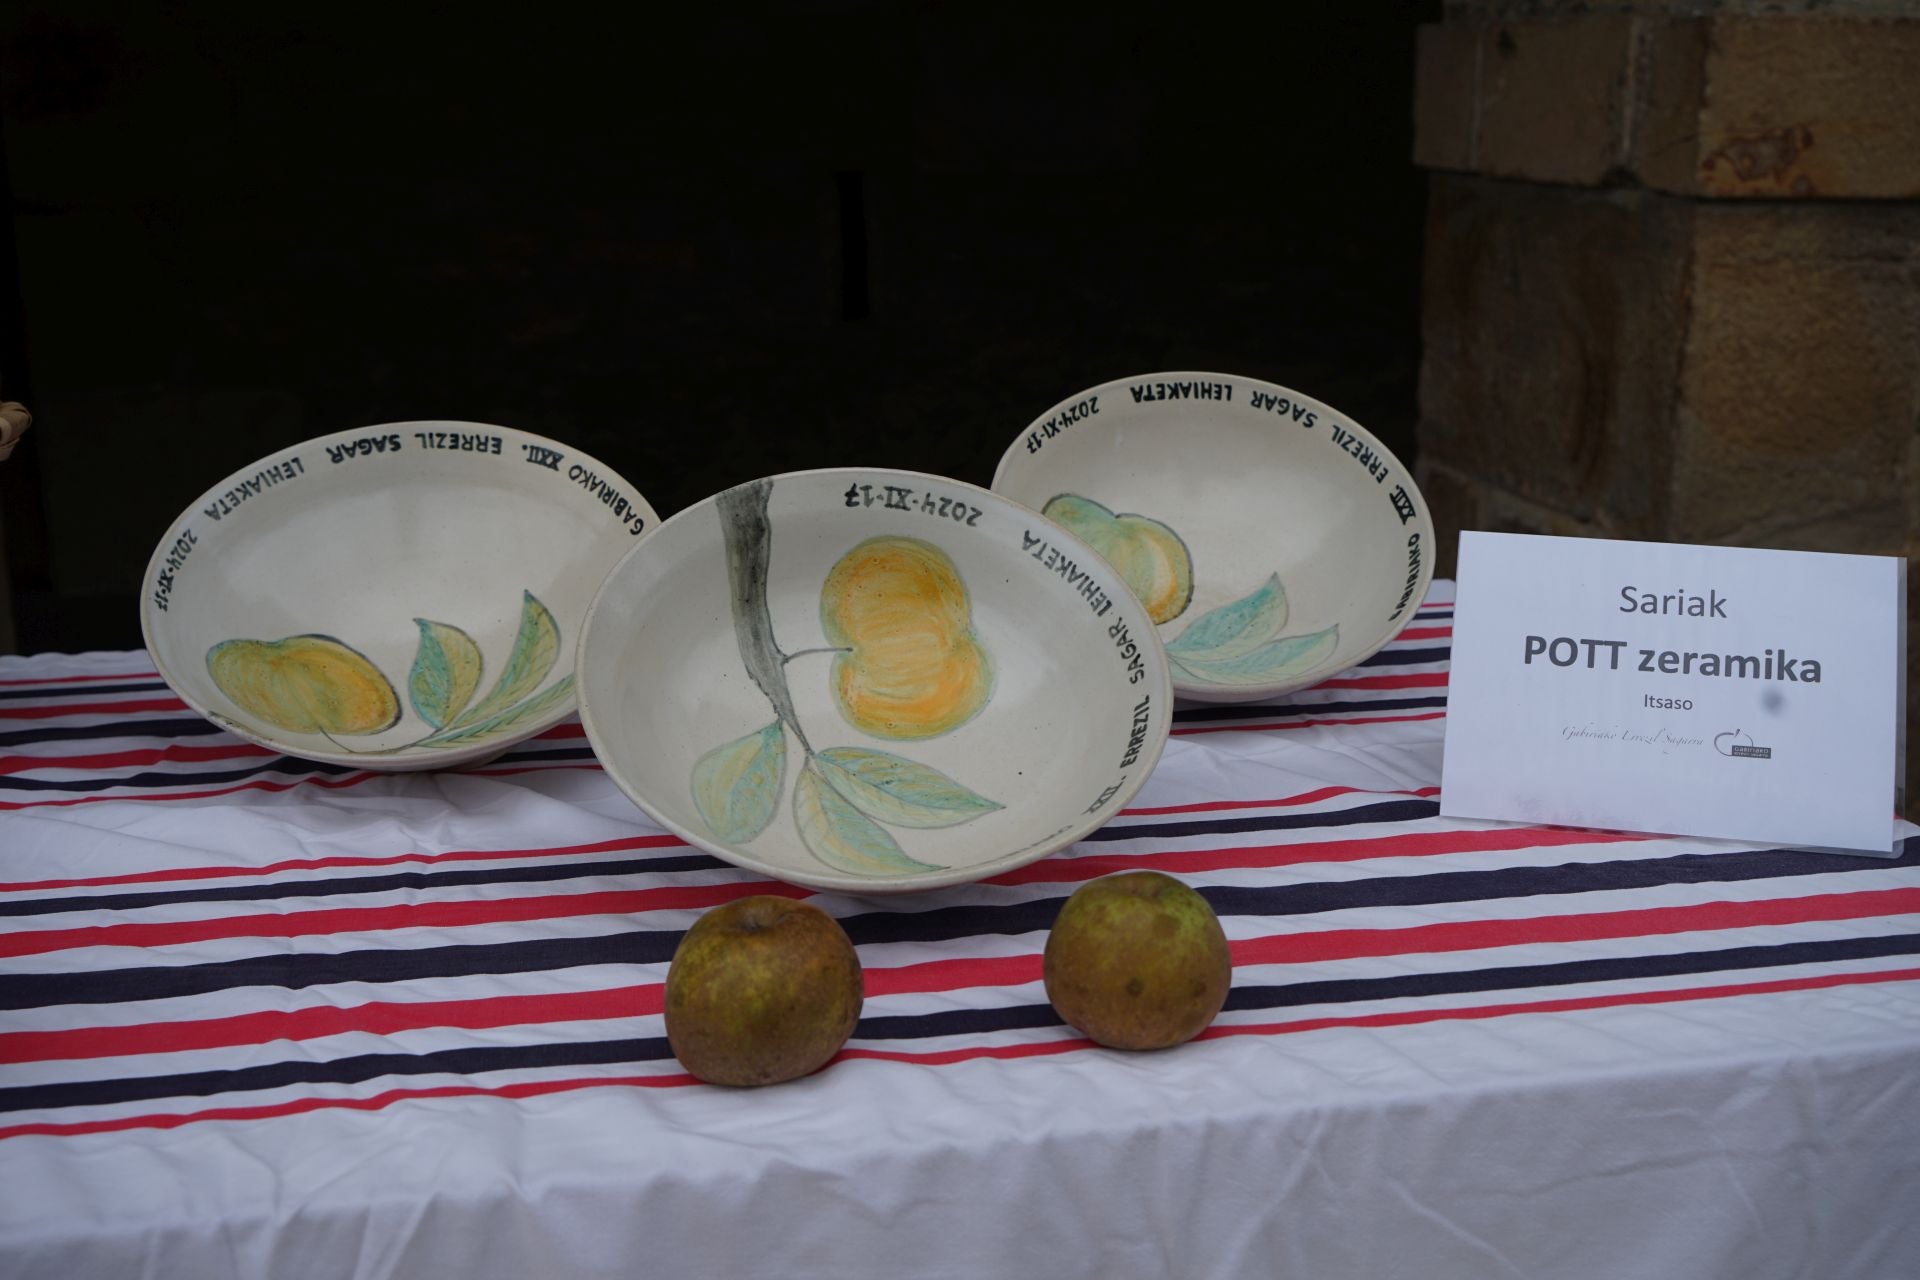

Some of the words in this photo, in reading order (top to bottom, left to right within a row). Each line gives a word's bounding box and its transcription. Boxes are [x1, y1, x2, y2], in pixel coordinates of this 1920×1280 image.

[1129, 382, 1233, 403] LEHIAKETA
[1250, 391, 1319, 429] SAGAR
[325, 434, 402, 464] SAGAR
[414, 432, 503, 456] ERREZIL
[1331, 424, 1389, 483] ERREZIL
[203, 456, 305, 522] LEHIAKETA
[568, 463, 645, 536] GABIRIAKO
[1019, 531, 1113, 618] LEHIAKETA
[1619, 584, 1728, 619] Sariak
[1107, 616, 1147, 684] SAGAR
[1523, 634, 1628, 671] POTT
[1638, 647, 1823, 684] zeramika
[1643, 693, 1694, 712] Itsaso
[1118, 695, 1151, 770] ERREZIL
